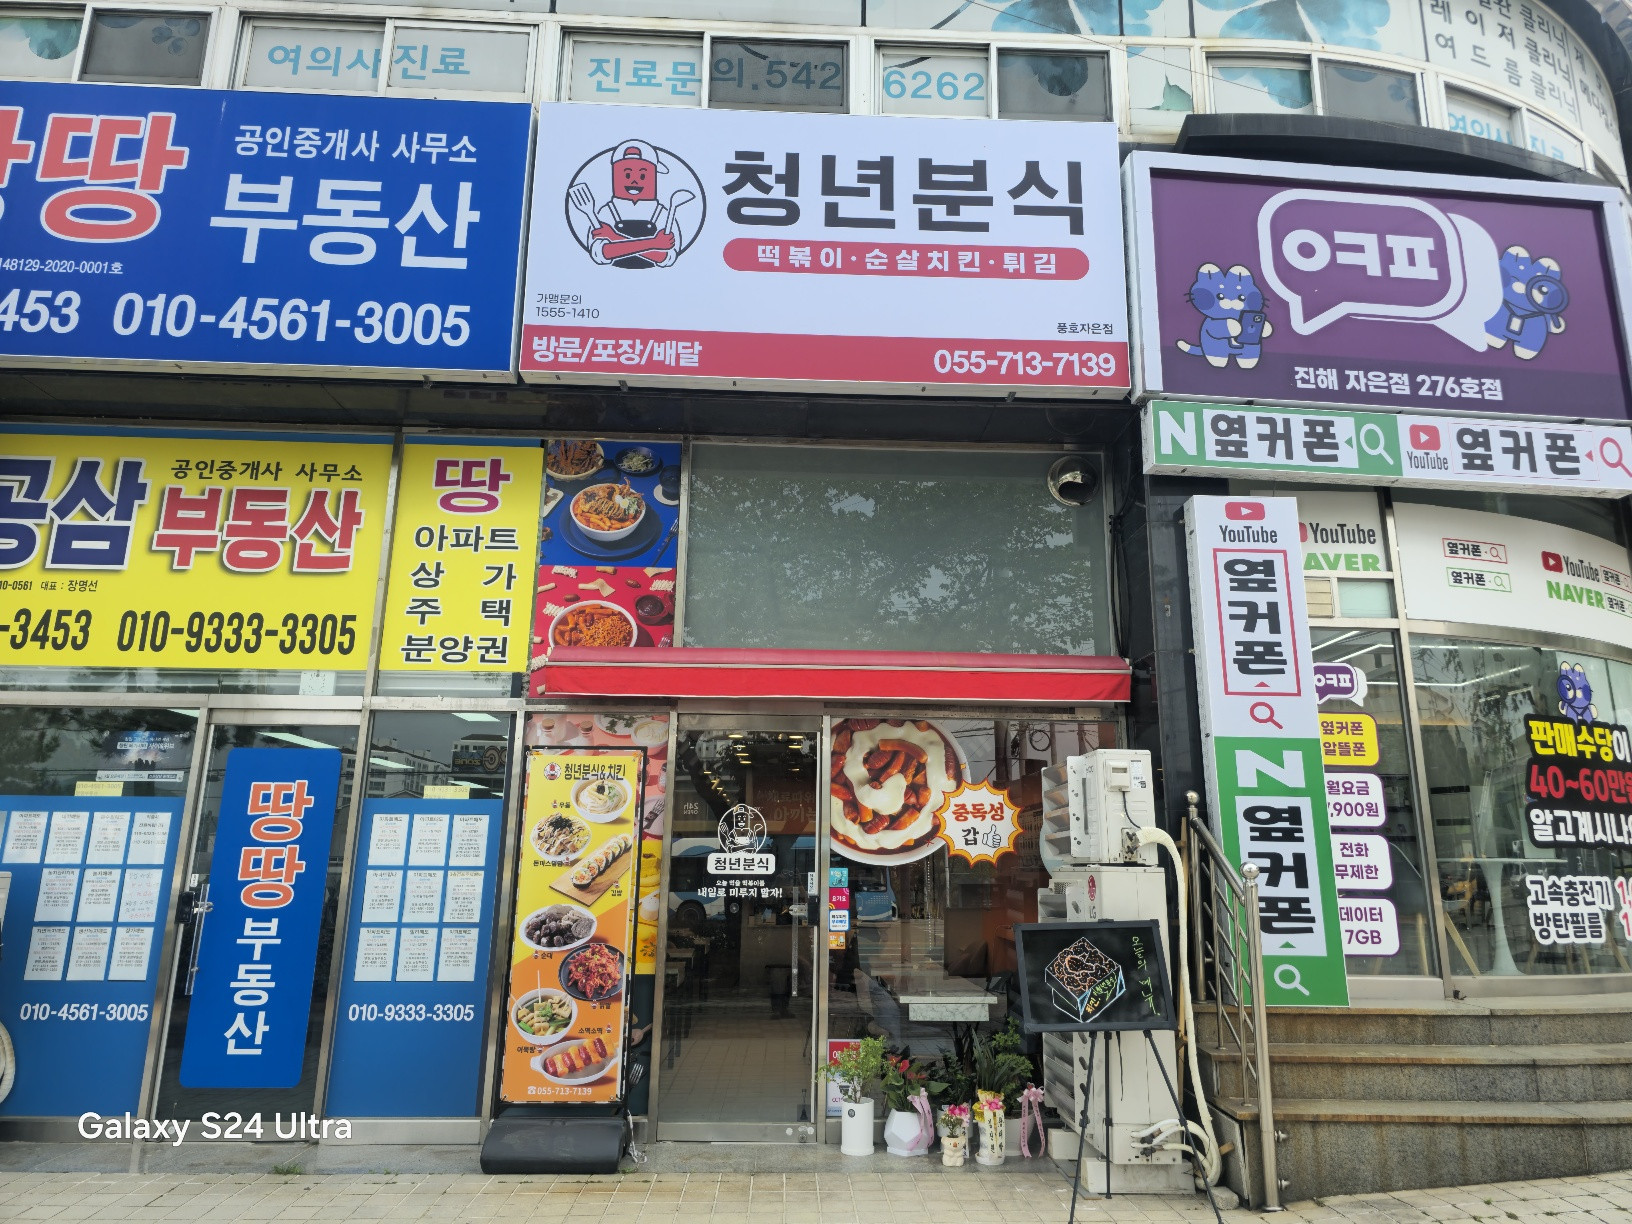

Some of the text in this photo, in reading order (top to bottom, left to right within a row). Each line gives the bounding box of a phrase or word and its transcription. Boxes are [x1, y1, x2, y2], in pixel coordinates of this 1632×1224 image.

[1520, 4, 1568, 57] 클리닉
[1430, 0, 1573, 90] 레이저 클리닉
[267, 44, 471, 80] 여의사 진료
[884, 69, 985, 101] 6262
[1435, 33, 1578, 123] 여드름 클리닉
[235, 124, 477, 163] 공인중개사 사무소
[0, 105, 189, 243] 땅
[722, 149, 1086, 237] 청년분식
[209, 172, 482, 271] 부동산
[535, 306, 600, 320] 1555-1410
[536, 293, 582, 306] 가맹문의
[113, 292, 472, 348] 010-4561-3005
[1056, 320, 1114, 336] 풍호자은점
[933, 348, 1116, 379] 055-713-7139
[1294, 365, 1504, 402] 진해 자은점 276호점
[1210, 412, 1340, 464] 옆커폰
[1455, 427, 1582, 477] 옆커폰
[171, 459, 364, 483] 공인중개사 사무소
[1406, 450, 1449, 472] YouTube
[432, 457, 513, 515] 땅
[153, 485, 364, 574] 부동산
[413, 524, 521, 554] 아파트
[1219, 525, 1278, 544] YouTube
[1309, 522, 1376, 545] YouTube
[1302, 552, 1381, 572] AVER
[1447, 541, 1482, 558] 옆커폰
[1451, 570, 1486, 587] 옆커폰
[1562, 555, 1600, 583] YouTube
[40, 581, 58, 591] 대표
[67, 579, 99, 592] 장명선
[1546, 580, 1605, 610] NAVER
[1223, 557, 1288, 676] 옆커폰
[117, 610, 358, 655] 010-9333-3305
[400, 634, 510, 666] 분양권
[1321, 720, 1364, 736] 옆커폰
[1528, 720, 1632, 763] 판매수당이
[1323, 741, 1366, 757] 알뜰폰
[564, 763, 626, 781] 청년분식&치킨
[1327, 780, 1370, 796] 월요금
[951, 802, 1005, 822] 중독성
[1327, 802, 1380, 818] ,900원
[239, 779, 315, 911] 땅땅
[961, 826, 979, 846] 갑
[1339, 841, 1369, 859] 전화
[714, 857, 769, 872] 청년분식
[1243, 805, 1316, 934] 옆커폰
[1334, 863, 1379, 881] 무제한
[697, 886, 783, 899] 내일로 미루지 말자!
[1529, 879, 1612, 909] 고속충전기
[1339, 906, 1384, 924] 데이터
[1533, 912, 1603, 940] 방탄필름
[1346, 929, 1382, 946] 7GB
[223, 917, 283, 1056] 부동산
[20, 1002, 149, 1023] 010-4561-3005
[348, 1003, 475, 1024] 010-9333-3305
[537, 1087, 592, 1096] 055-713-7139
